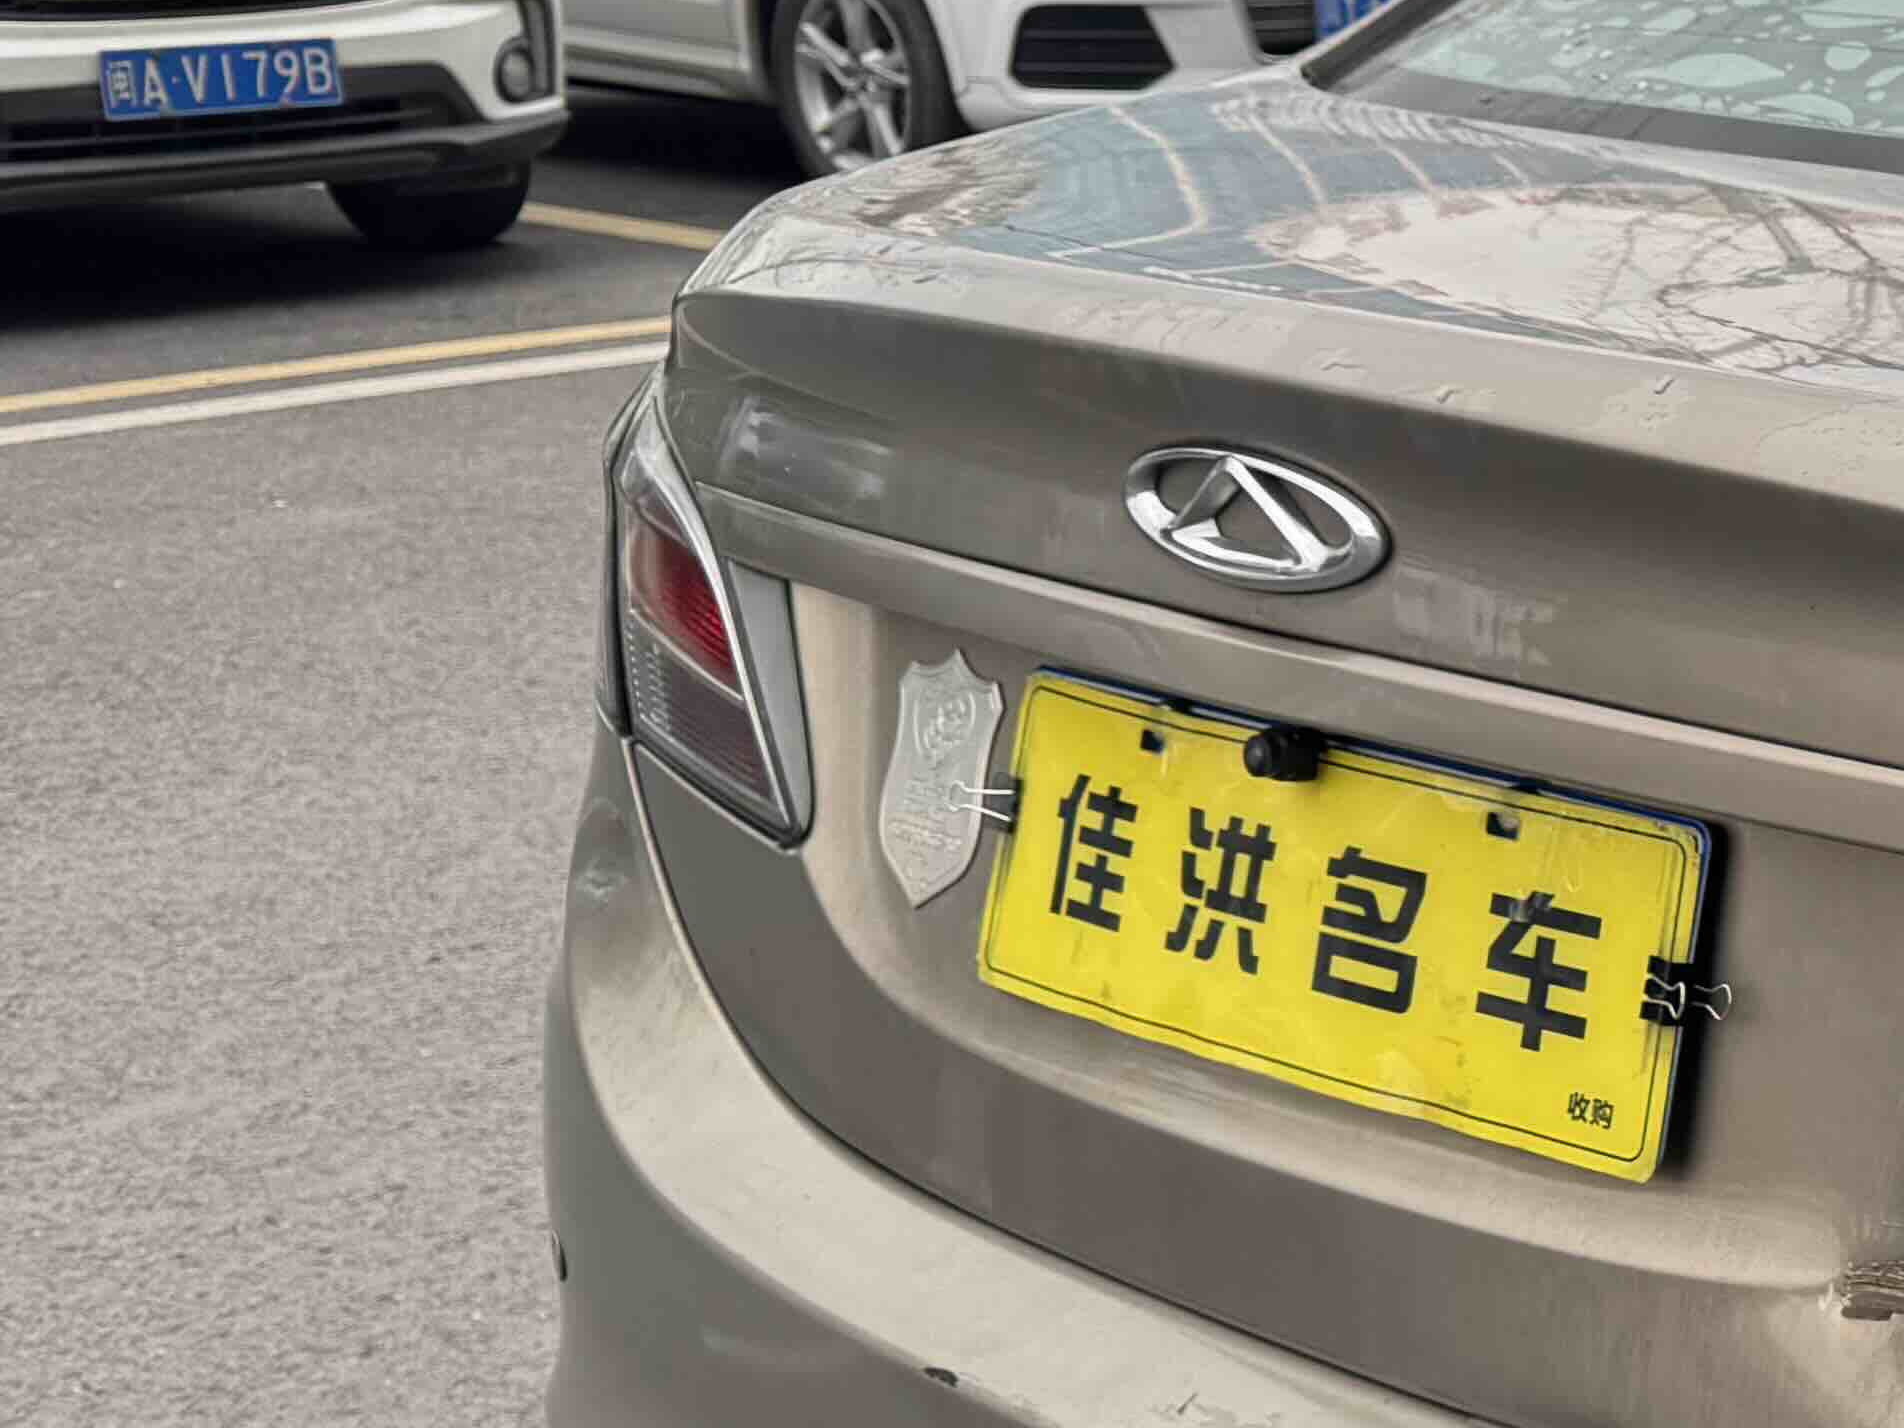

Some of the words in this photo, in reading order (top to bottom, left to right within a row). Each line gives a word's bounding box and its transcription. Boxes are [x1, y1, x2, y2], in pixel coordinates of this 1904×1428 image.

[1049, 774, 1602, 1052] 佳洪名车
[1568, 1092, 1614, 1129] 收购
